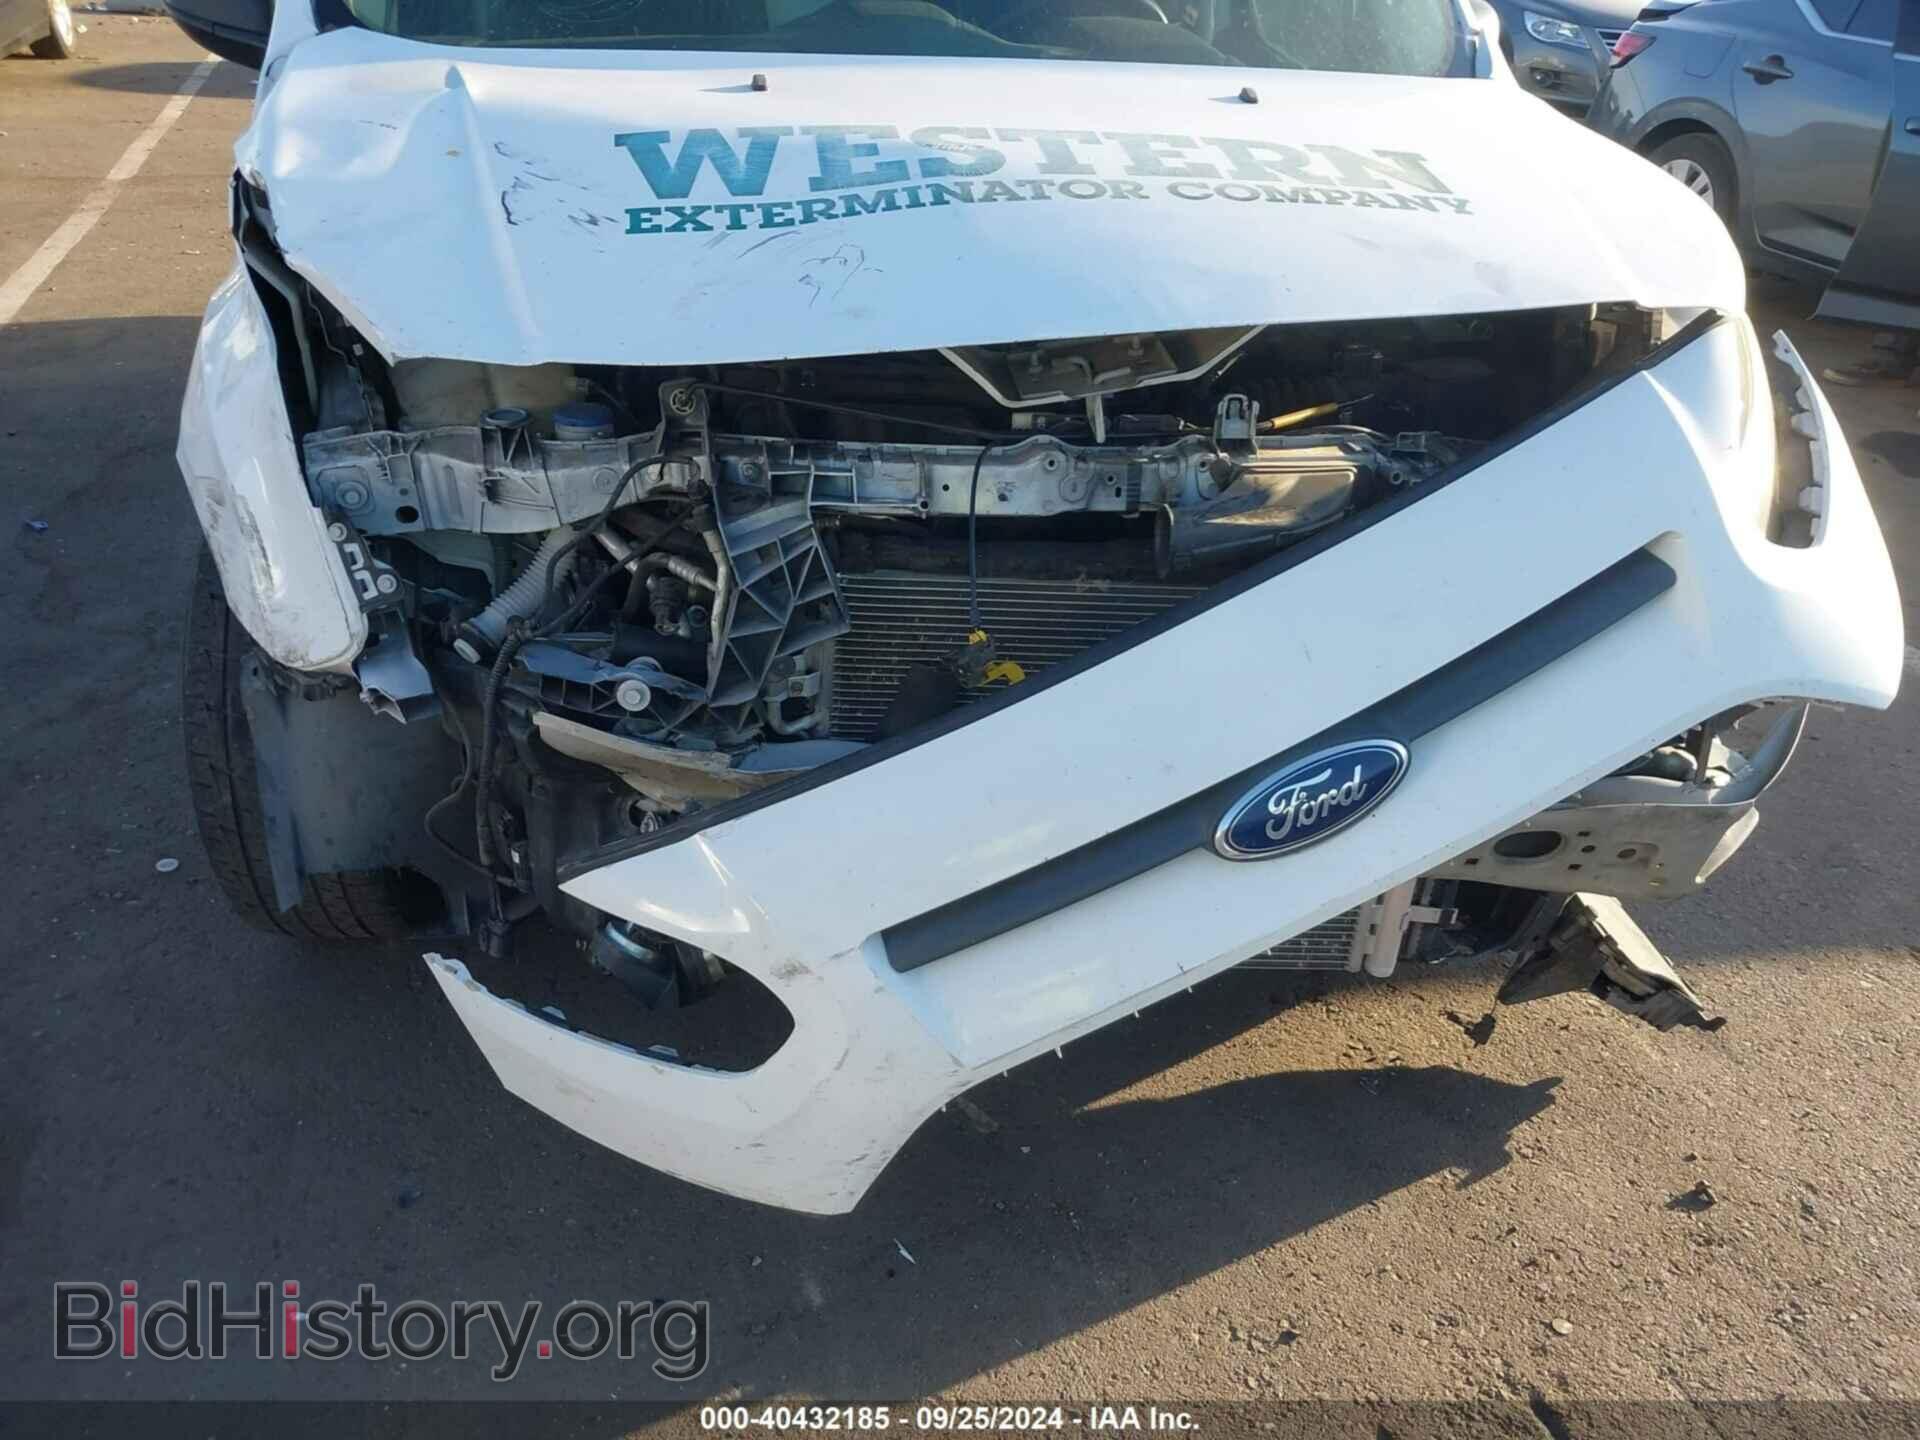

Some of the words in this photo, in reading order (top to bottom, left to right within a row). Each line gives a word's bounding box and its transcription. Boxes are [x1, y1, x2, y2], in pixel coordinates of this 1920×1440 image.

[614, 125, 1453, 199] WESTERN
[624, 179, 1150, 234] EXTERMINATOR
[1166, 182, 1474, 216] COMPANY
[1266, 764, 1367, 840] Ford
